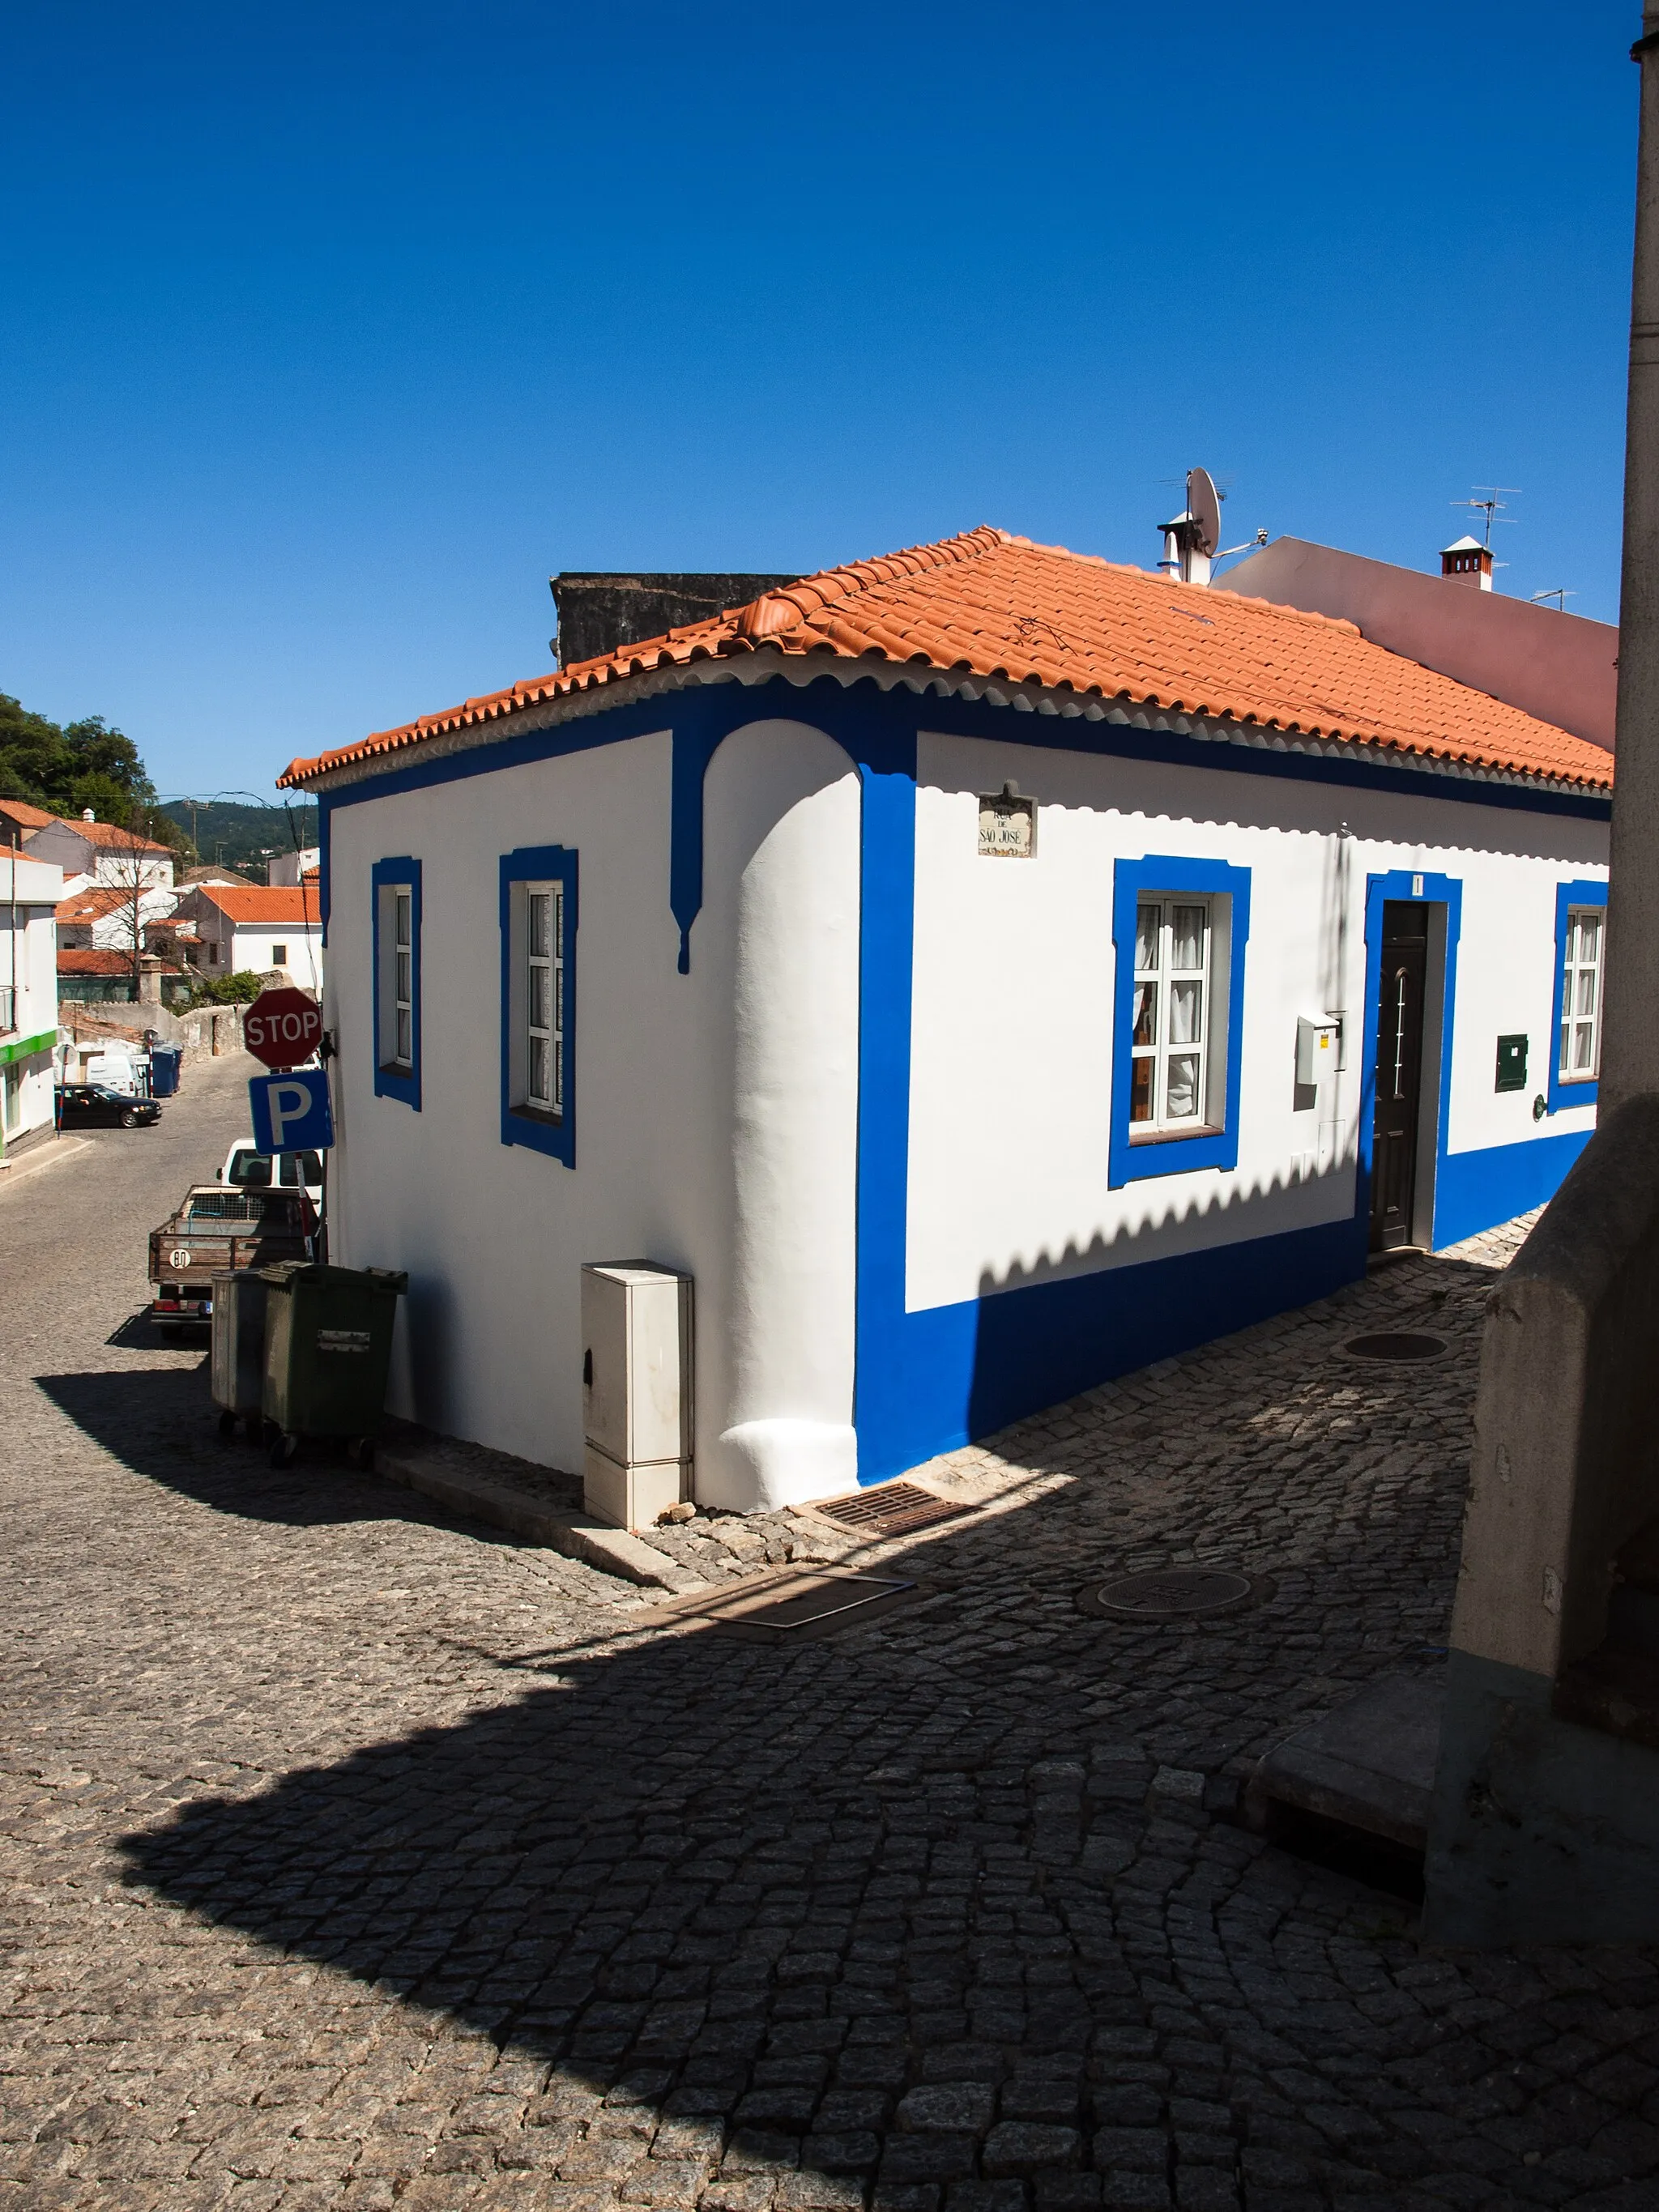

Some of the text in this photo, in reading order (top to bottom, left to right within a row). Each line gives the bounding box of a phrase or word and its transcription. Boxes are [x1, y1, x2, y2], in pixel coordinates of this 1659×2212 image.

[993, 809, 1012, 820] RUA
[980, 828, 1021, 845] SÃO JOSÉ
[247, 1011, 318, 1046] STOP
[267, 1081, 313, 1146] P
